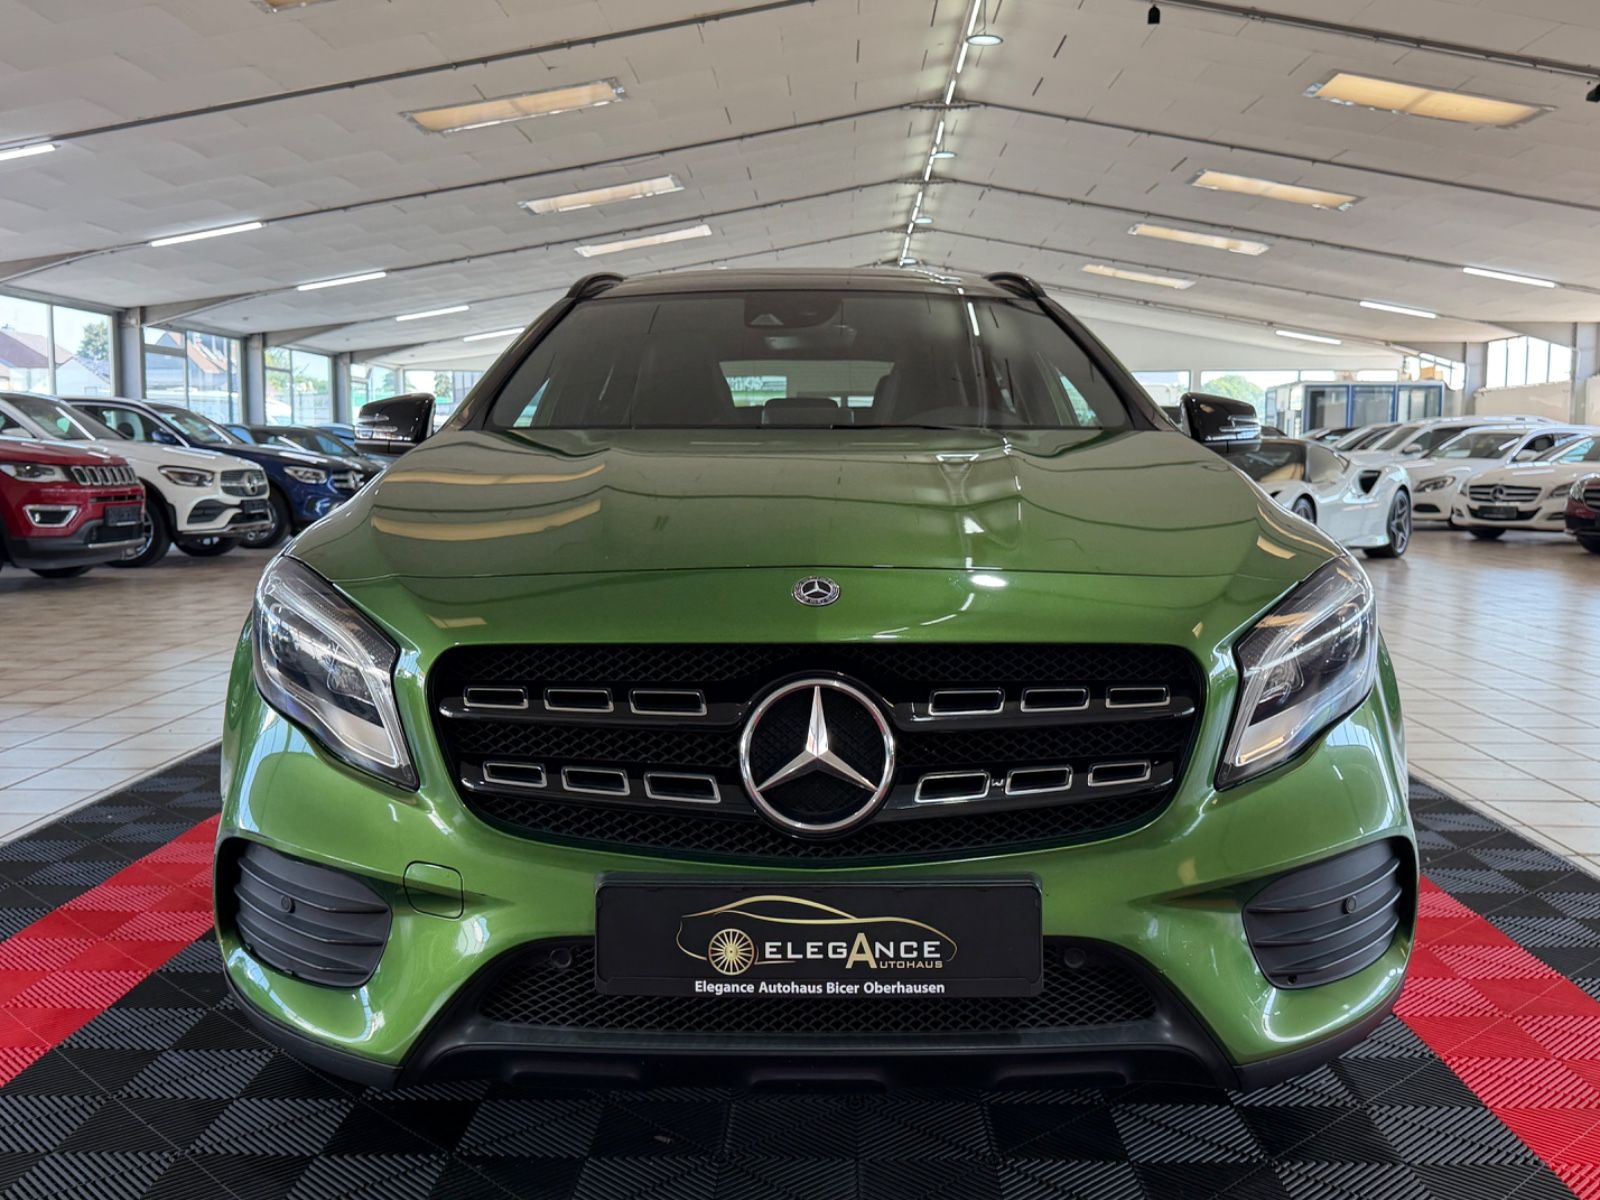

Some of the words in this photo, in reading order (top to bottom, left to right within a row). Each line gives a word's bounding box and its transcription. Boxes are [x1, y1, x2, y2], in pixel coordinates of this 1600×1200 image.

[765, 932, 941, 969] ELEGANCE
[695, 980, 755, 995] Elegance
[759, 980, 823, 994] Autohaus
[826, 981, 860, 994] Bicer
[863, 981, 945, 994] Oberhausen
